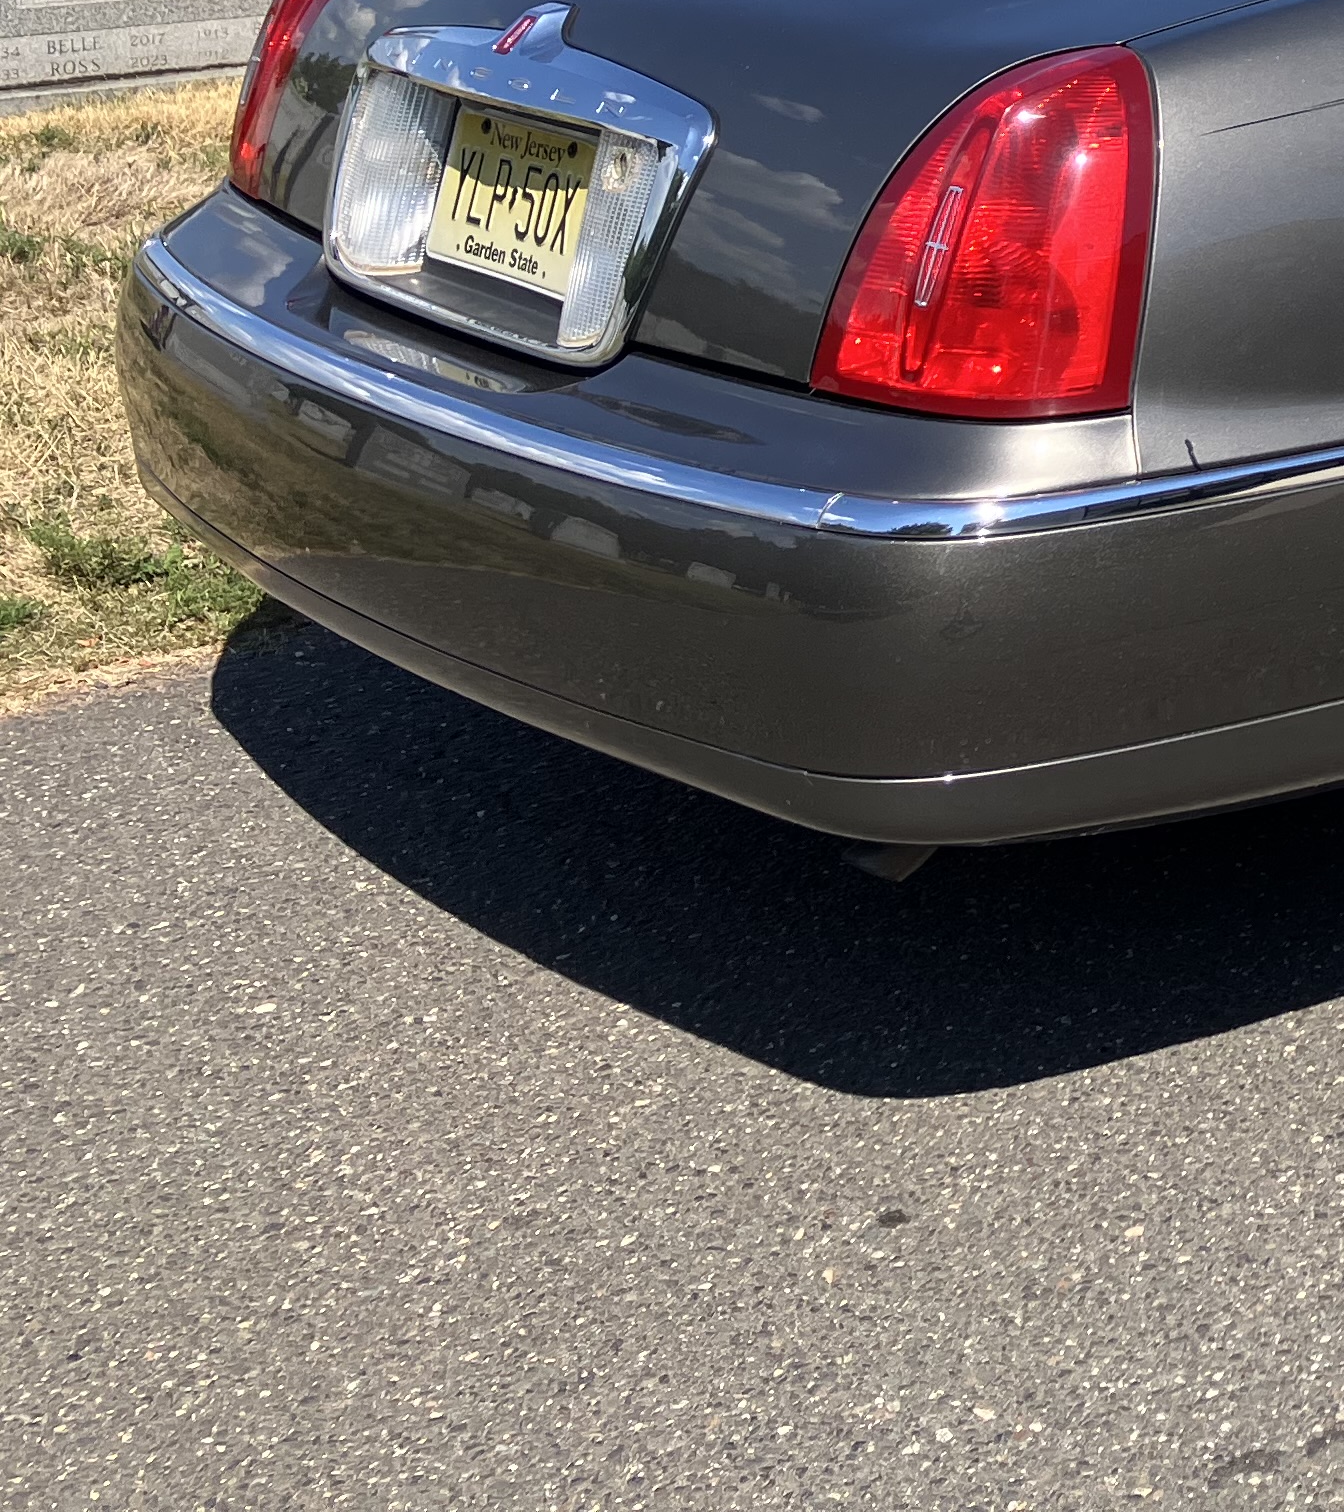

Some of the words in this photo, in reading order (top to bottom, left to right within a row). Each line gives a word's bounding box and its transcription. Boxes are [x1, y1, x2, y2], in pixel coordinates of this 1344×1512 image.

[47, 36, 103, 55] BELLE
[130, 32, 166, 47] 2017
[50, 57, 101, 76] ROSS
[130, 54, 168, 68] 2023
[489, 121, 522, 151] New
[520, 131, 567, 167] Jersey
[464, 234, 506, 265] Garden
[508, 248, 539, 276] State
